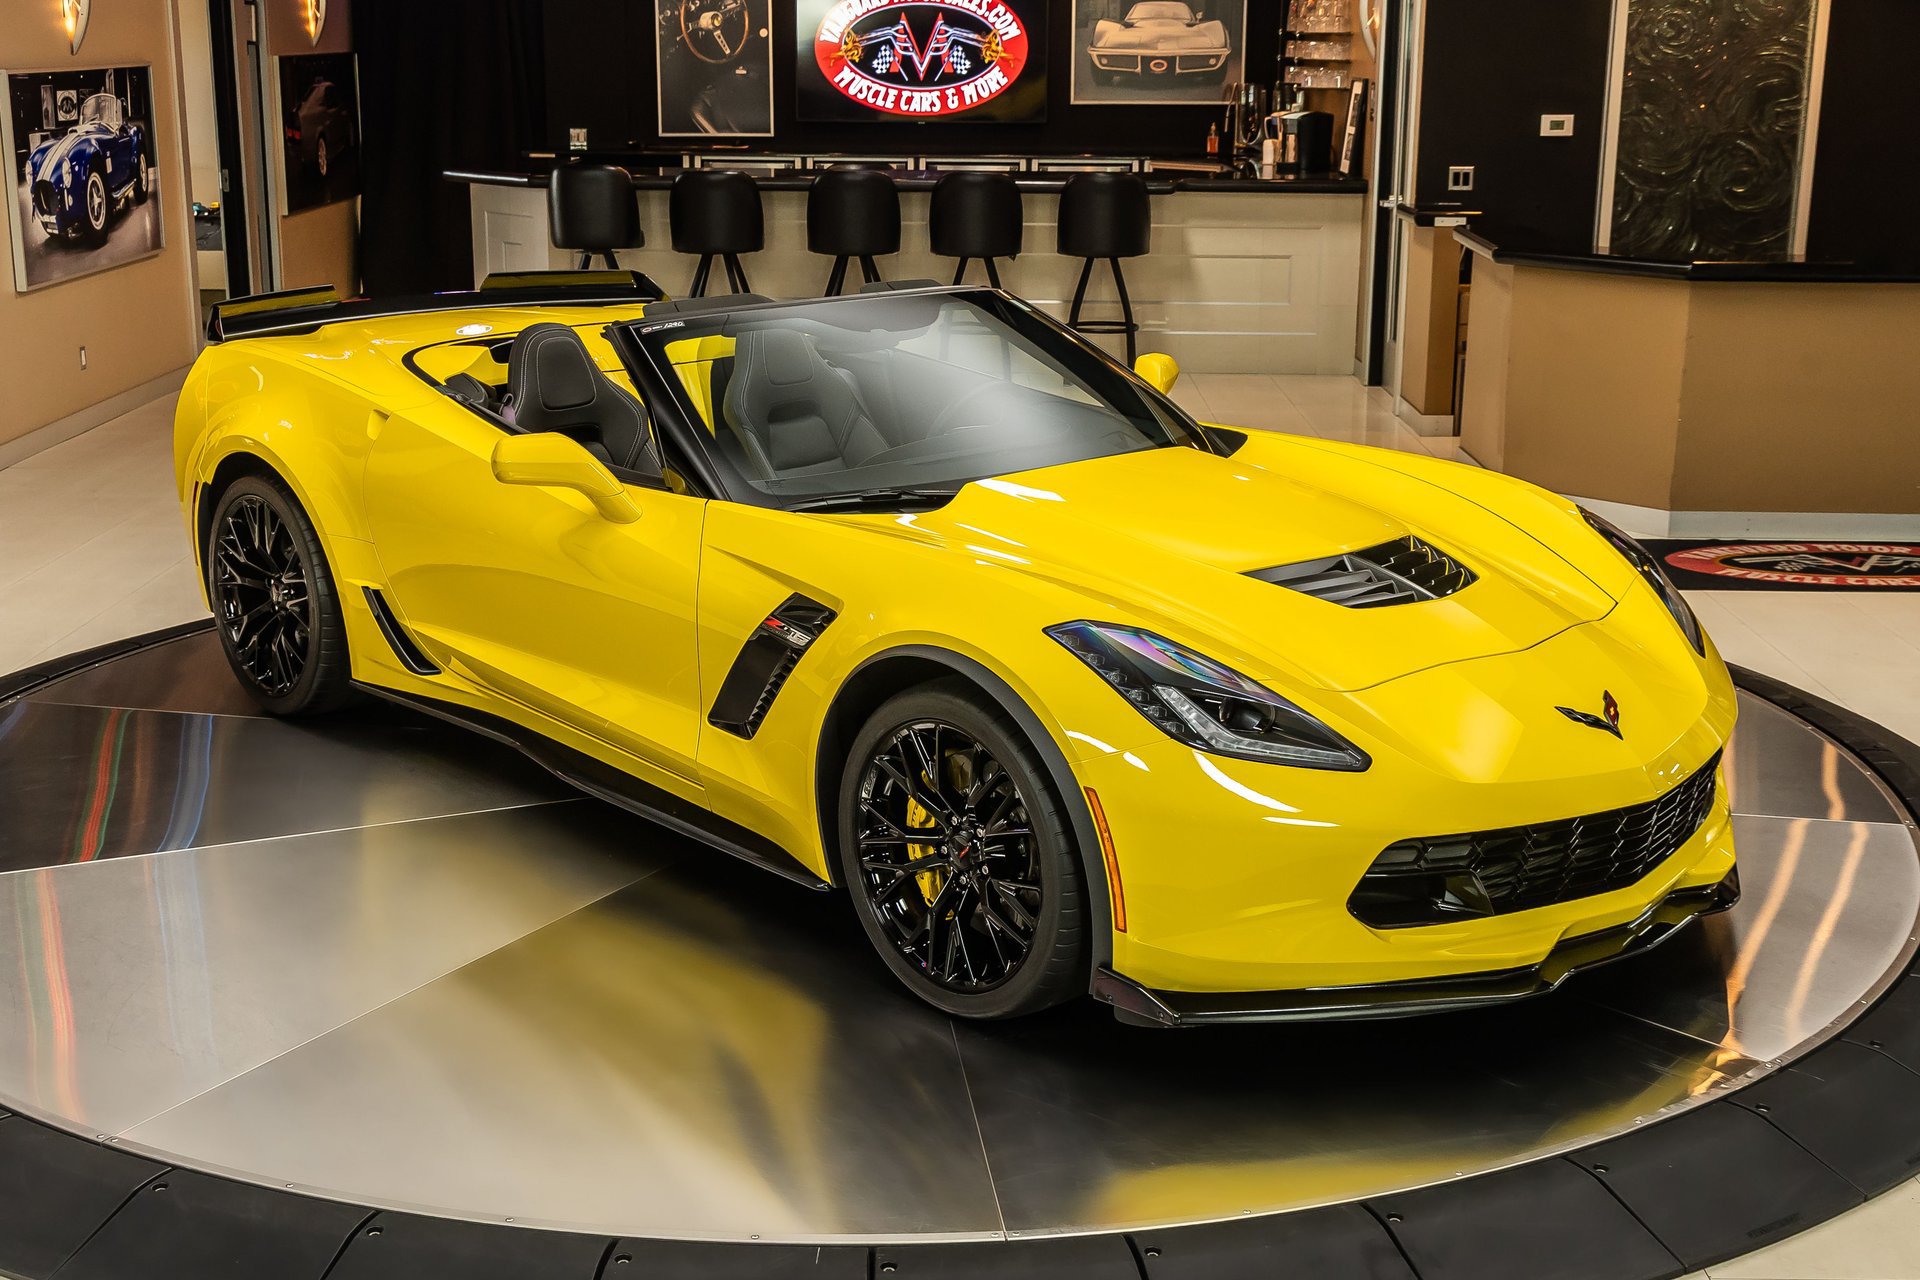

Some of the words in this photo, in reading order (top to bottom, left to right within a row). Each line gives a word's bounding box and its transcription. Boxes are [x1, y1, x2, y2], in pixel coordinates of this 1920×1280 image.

[833, 65, 898, 109] MUSCLE
[900, 90, 941, 112] CARS
[945, 87, 959, 110] &
[960, 65, 1009, 106] MORE
[1811, 543, 1913, 555] MOTOR
[1713, 567, 1837, 585] MUSCLE
[1845, 576, 1920, 587] CARS
